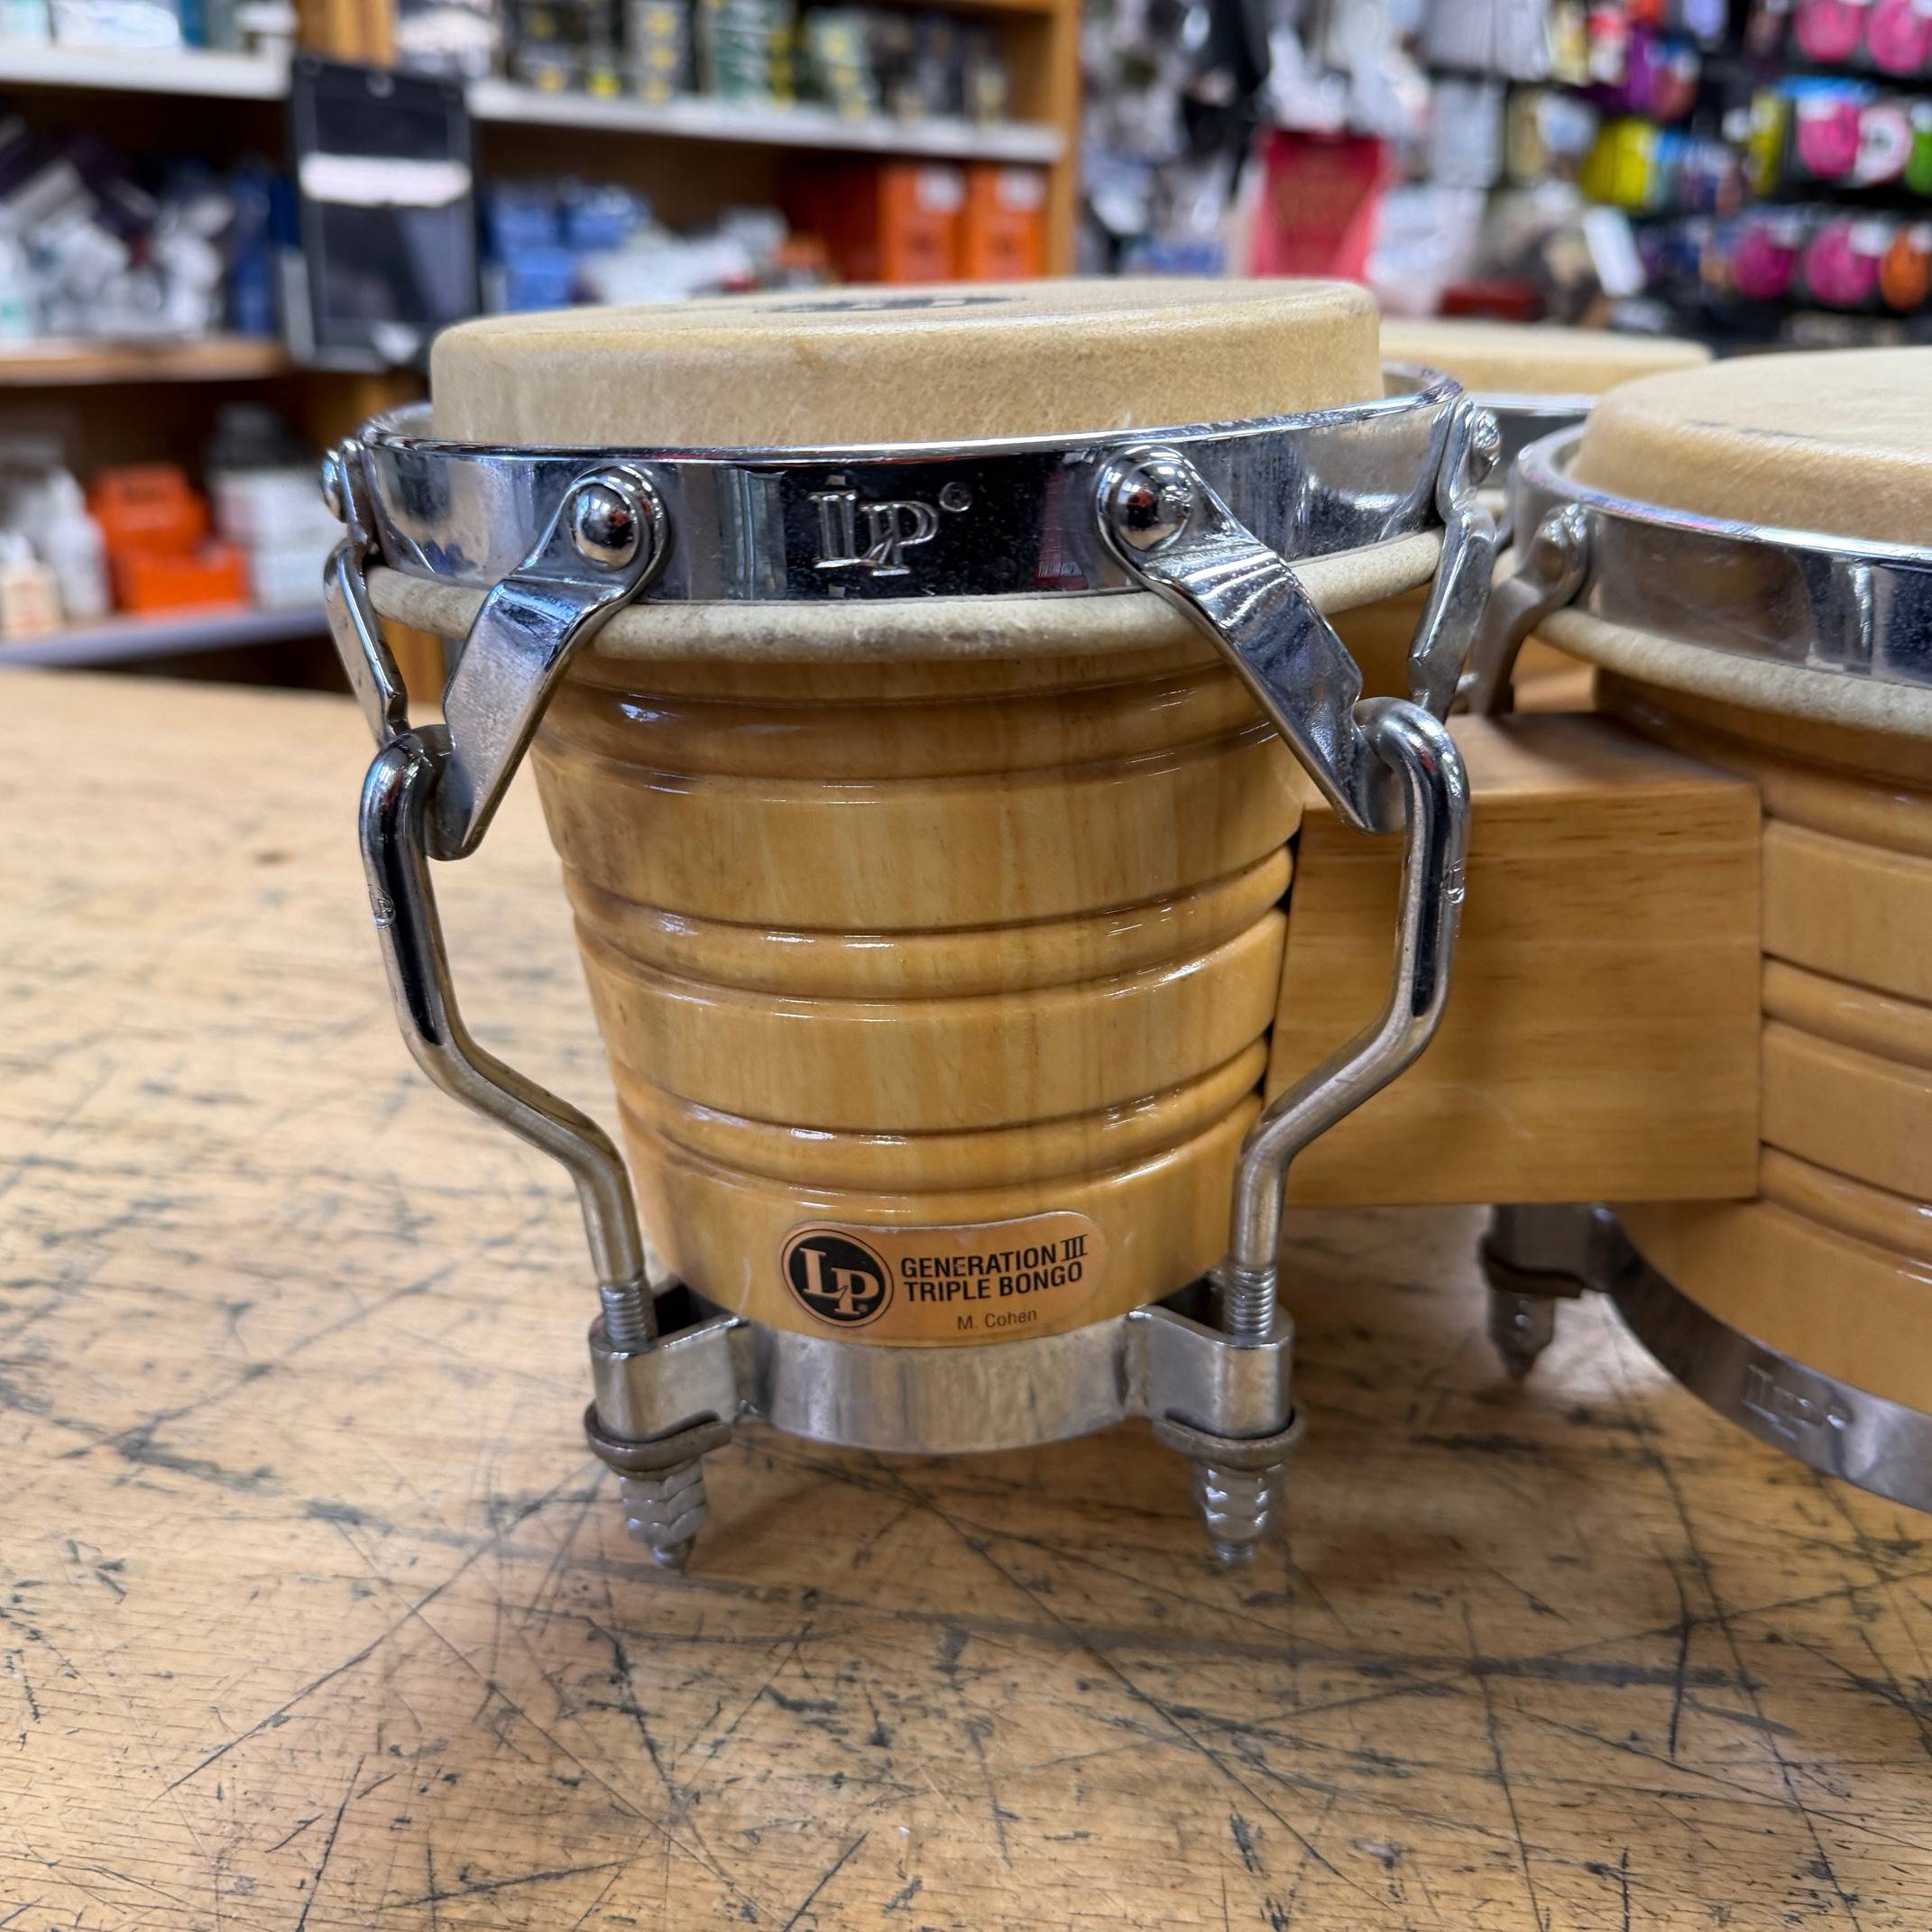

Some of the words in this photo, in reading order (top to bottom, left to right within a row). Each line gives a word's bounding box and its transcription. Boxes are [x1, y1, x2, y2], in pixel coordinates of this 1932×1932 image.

[809, 490, 939, 576] LP
[901, 1244, 1056, 1279] GENERATION
[1060, 1234, 1089, 1263] III
[799, 1247, 880, 1315] LP
[904, 1281, 991, 1302] TRIPLE
[998, 1262, 1082, 1297] BONGO
[957, 1314, 979, 1330] M.
[985, 1309, 1037, 1329] Cohen
